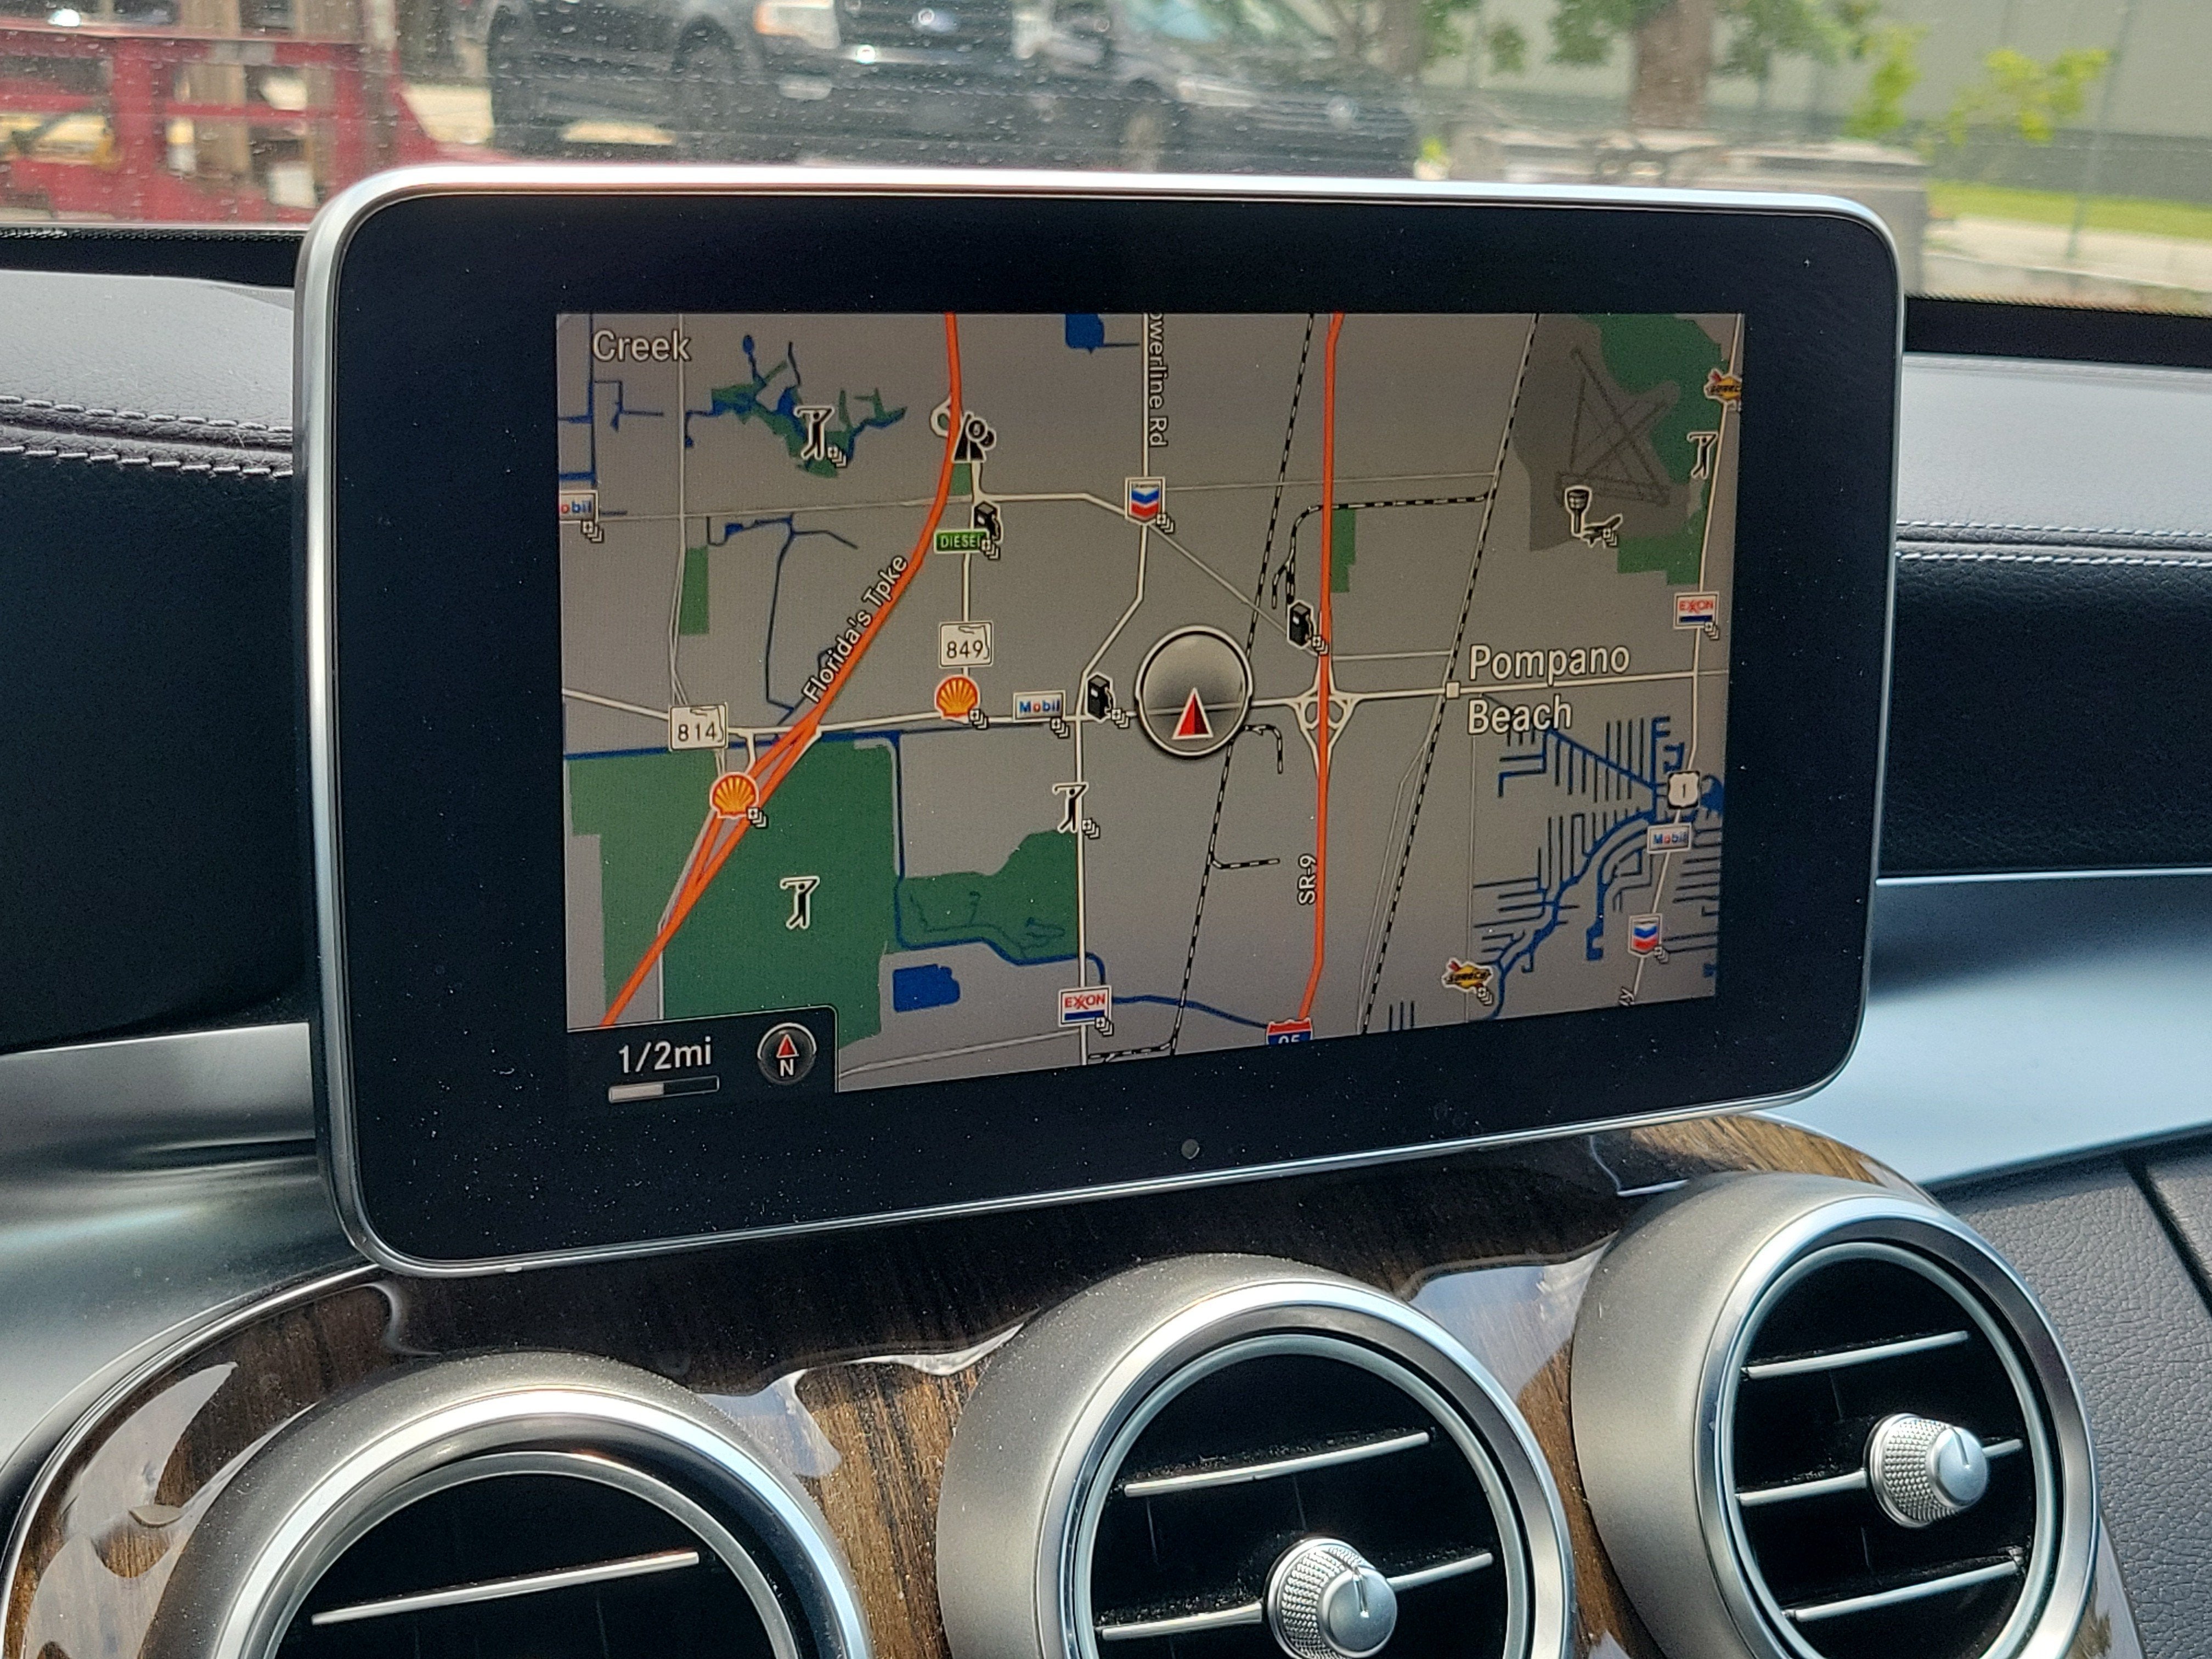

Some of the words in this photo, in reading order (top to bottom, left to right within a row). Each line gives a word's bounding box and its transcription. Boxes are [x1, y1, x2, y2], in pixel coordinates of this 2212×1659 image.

[592, 331, 691, 361] Creek
[1149, 417, 1167, 447] Rd
[803, 610, 872, 703] Florida's
[863, 556, 907, 606] Tpke
[946, 641, 984, 658] 849
[1470, 645, 1630, 686] Pompano
[1019, 699, 1060, 714] Mobil
[1468, 695, 1571, 733] Beach
[678, 724, 716, 741] 814
[1299, 855, 1317, 905] SR-9
[1065, 994, 1105, 1011] EXXON
[618, 1036, 712, 1073] 1/2mi
[780, 1060, 794, 1076] N
